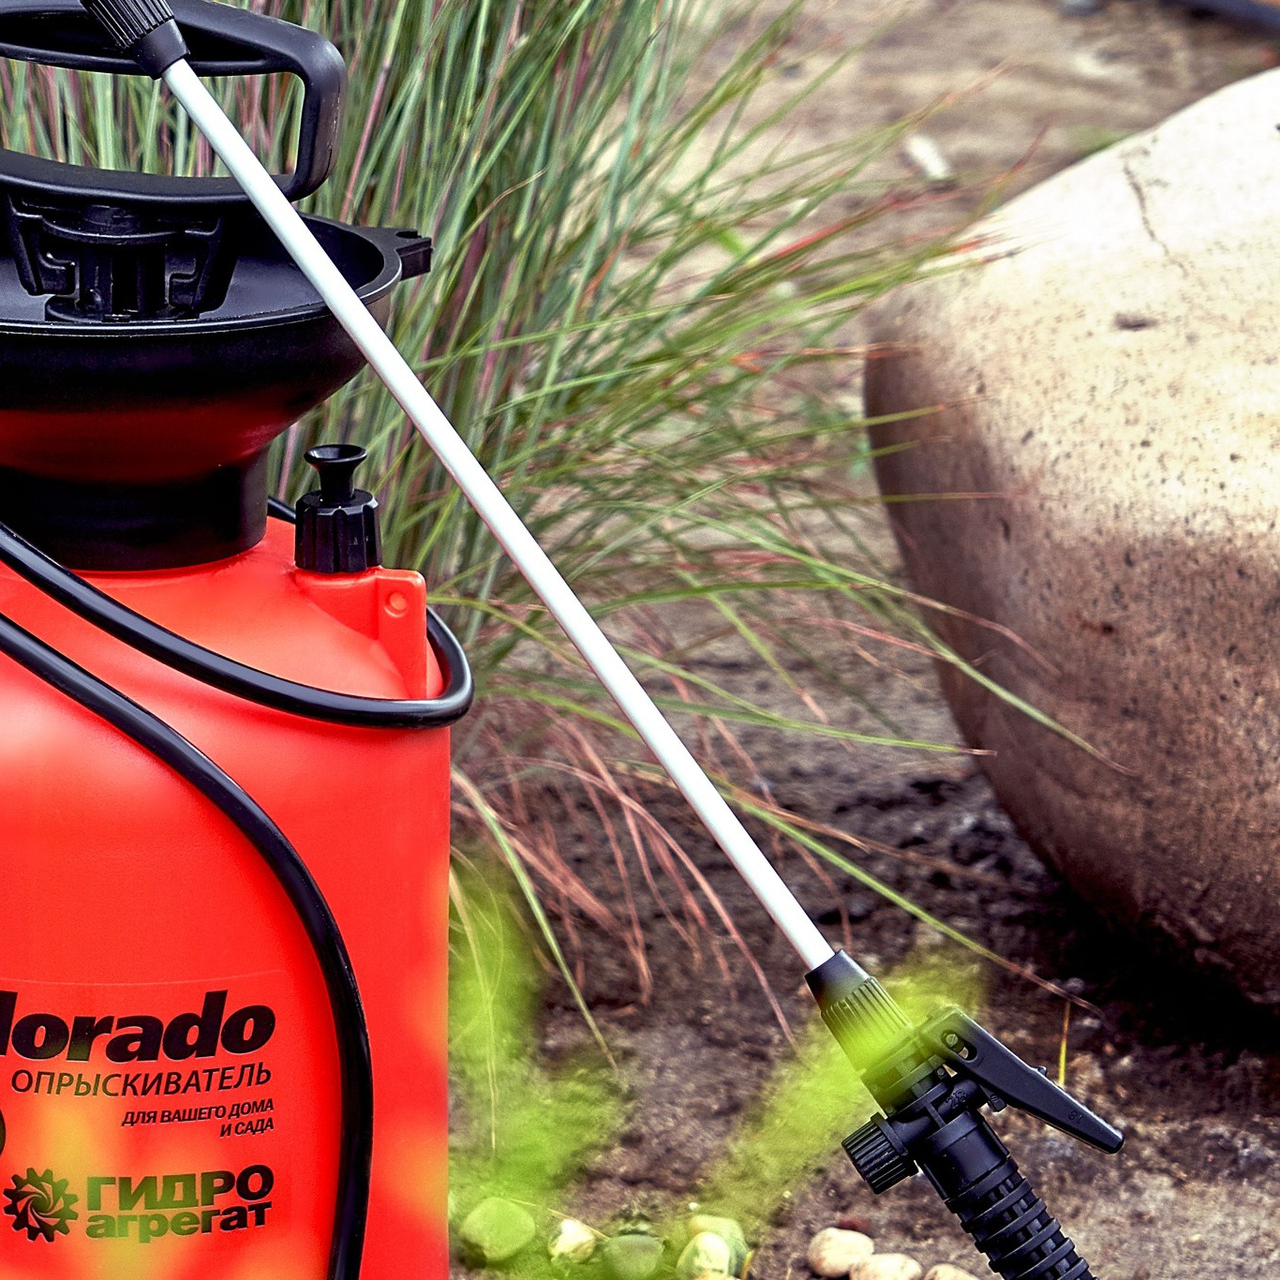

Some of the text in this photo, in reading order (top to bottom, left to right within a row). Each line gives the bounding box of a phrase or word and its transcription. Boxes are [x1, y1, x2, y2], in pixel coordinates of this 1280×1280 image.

[11, 1062, 272, 1096] ОПРЫСКИВАТЕЛЬ
[121, 1098, 274, 1127] ДЛЯ ВАШЕГО ДОМА
[220, 1118, 274, 1137] И САДА
[87, 1164, 273, 1211] ГИДРО
[86, 1202, 272, 1243] агрегат
